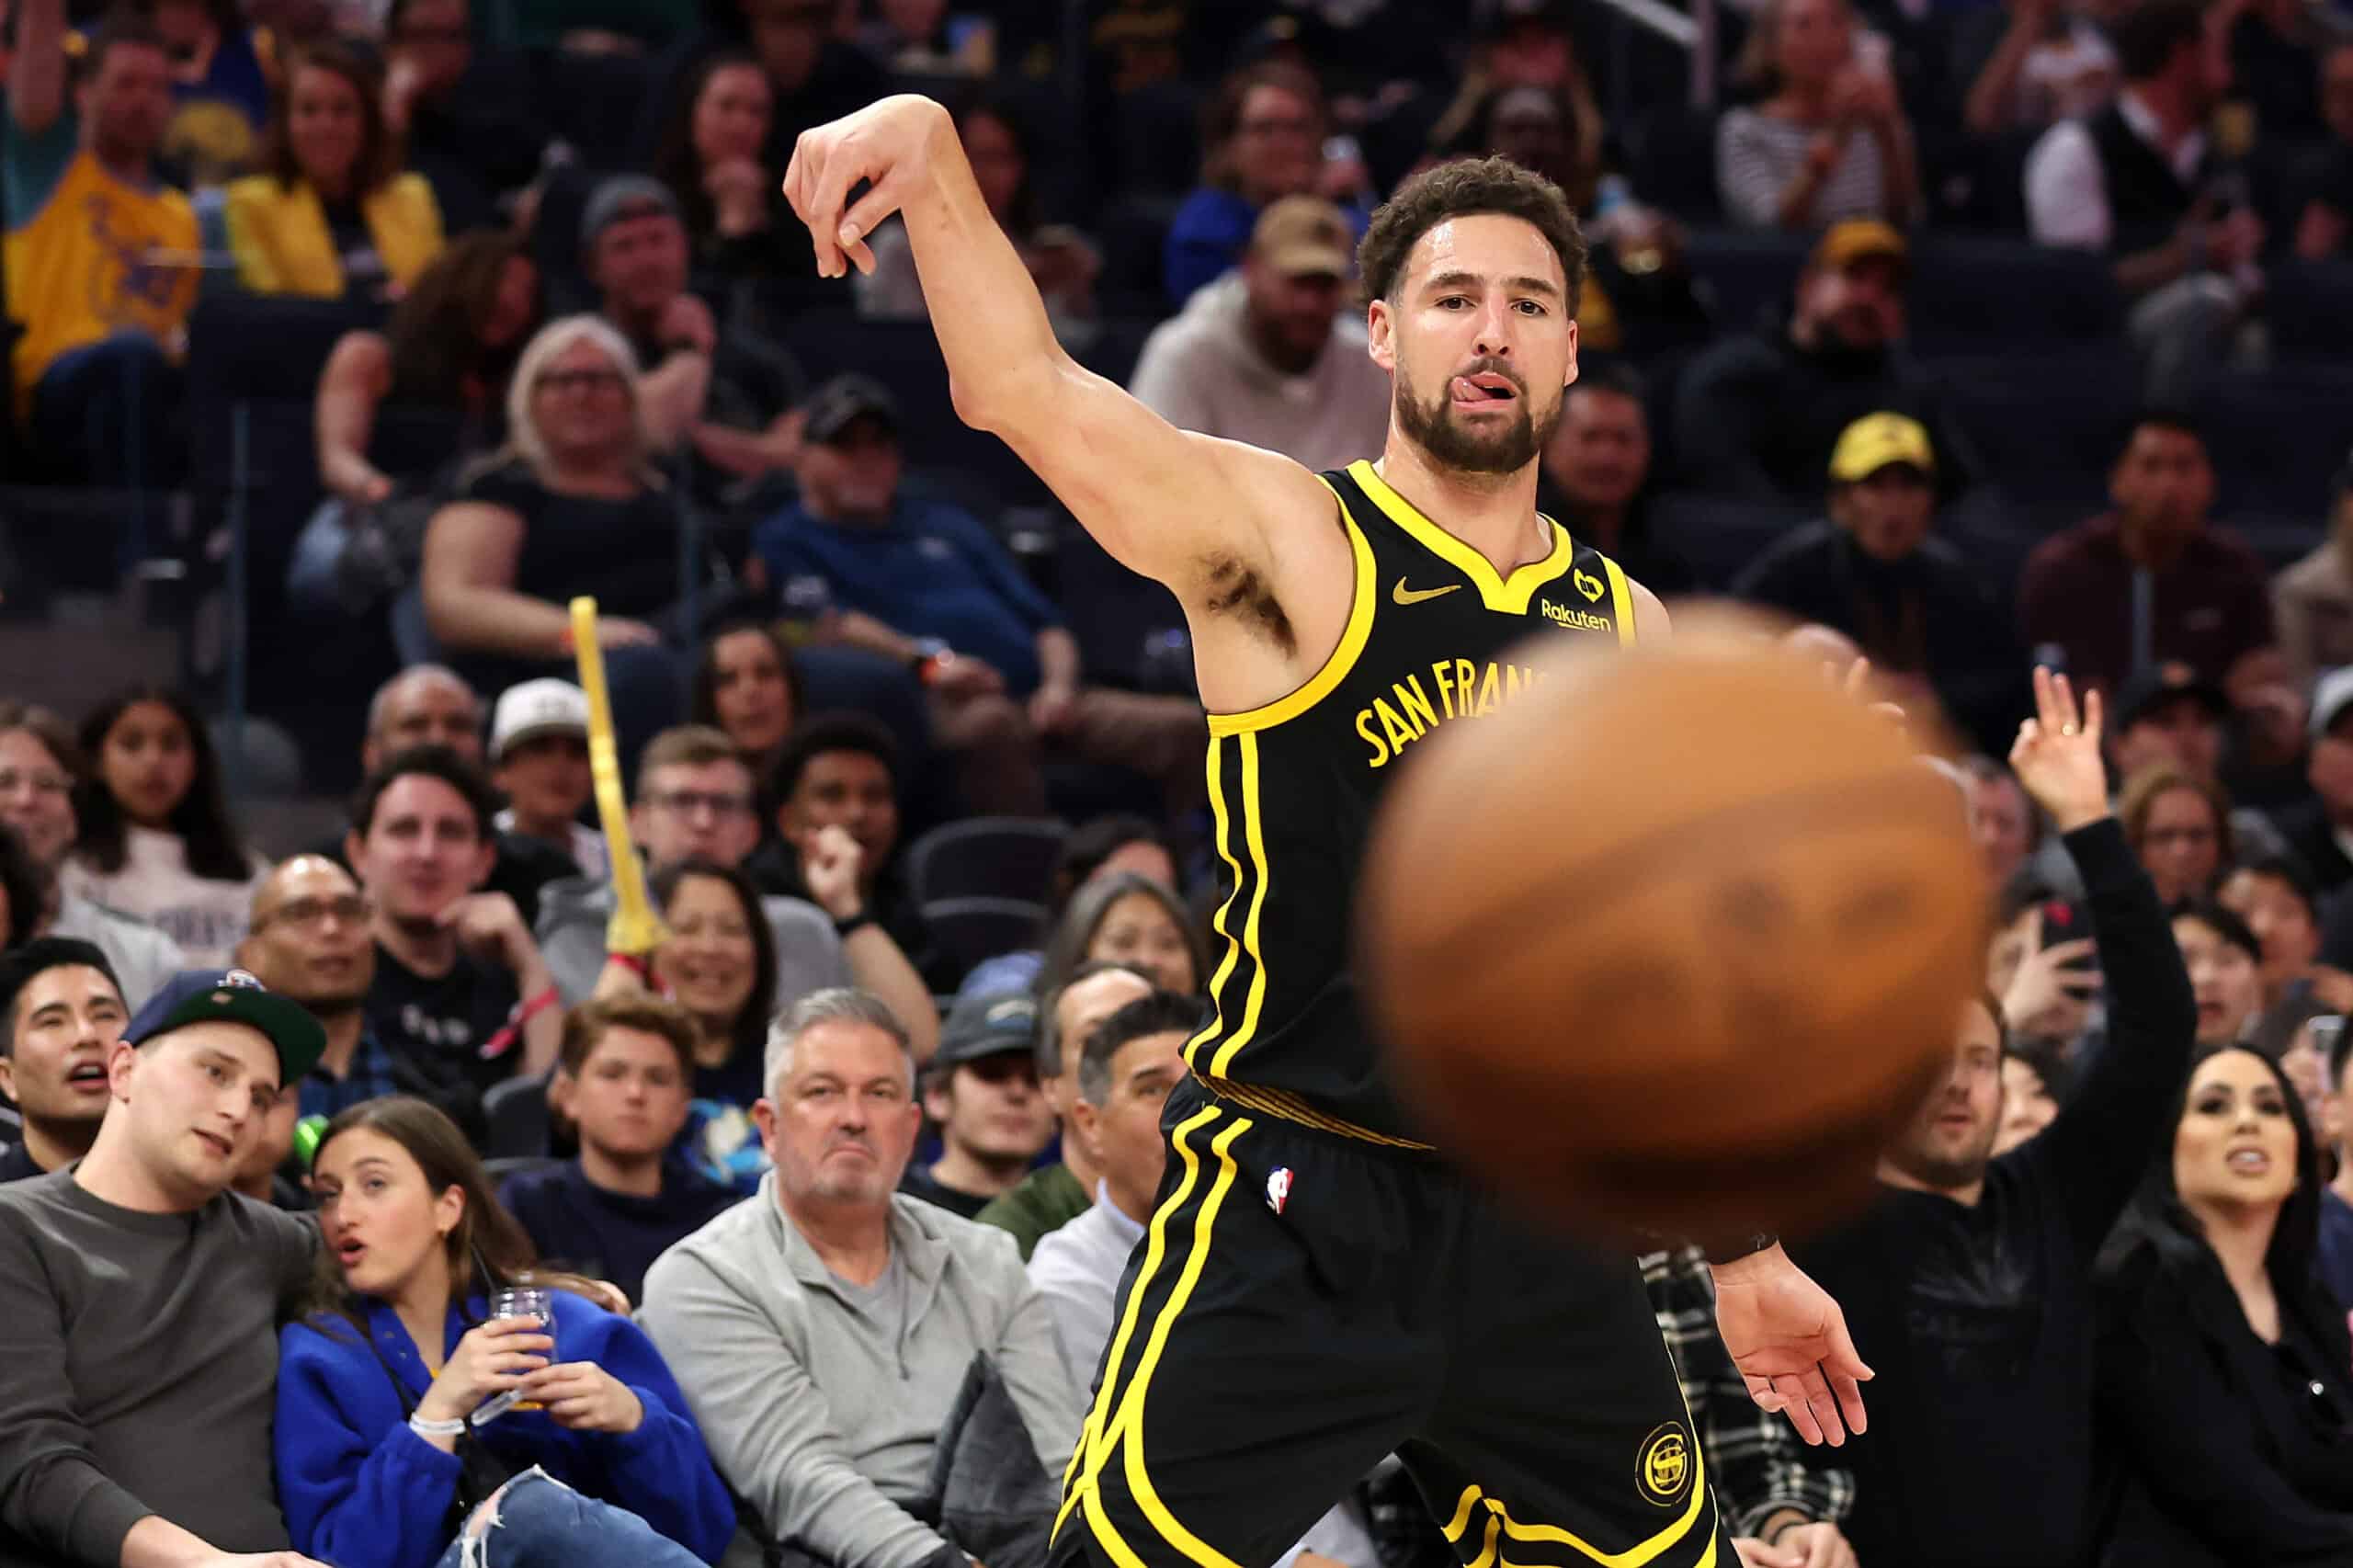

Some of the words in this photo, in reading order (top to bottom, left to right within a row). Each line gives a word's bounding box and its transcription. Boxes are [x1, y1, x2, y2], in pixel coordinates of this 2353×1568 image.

[1541, 598, 1611, 633] Rakuten
[1356, 674, 1439, 767] SAN
[1432, 658, 1549, 720] FRAN
